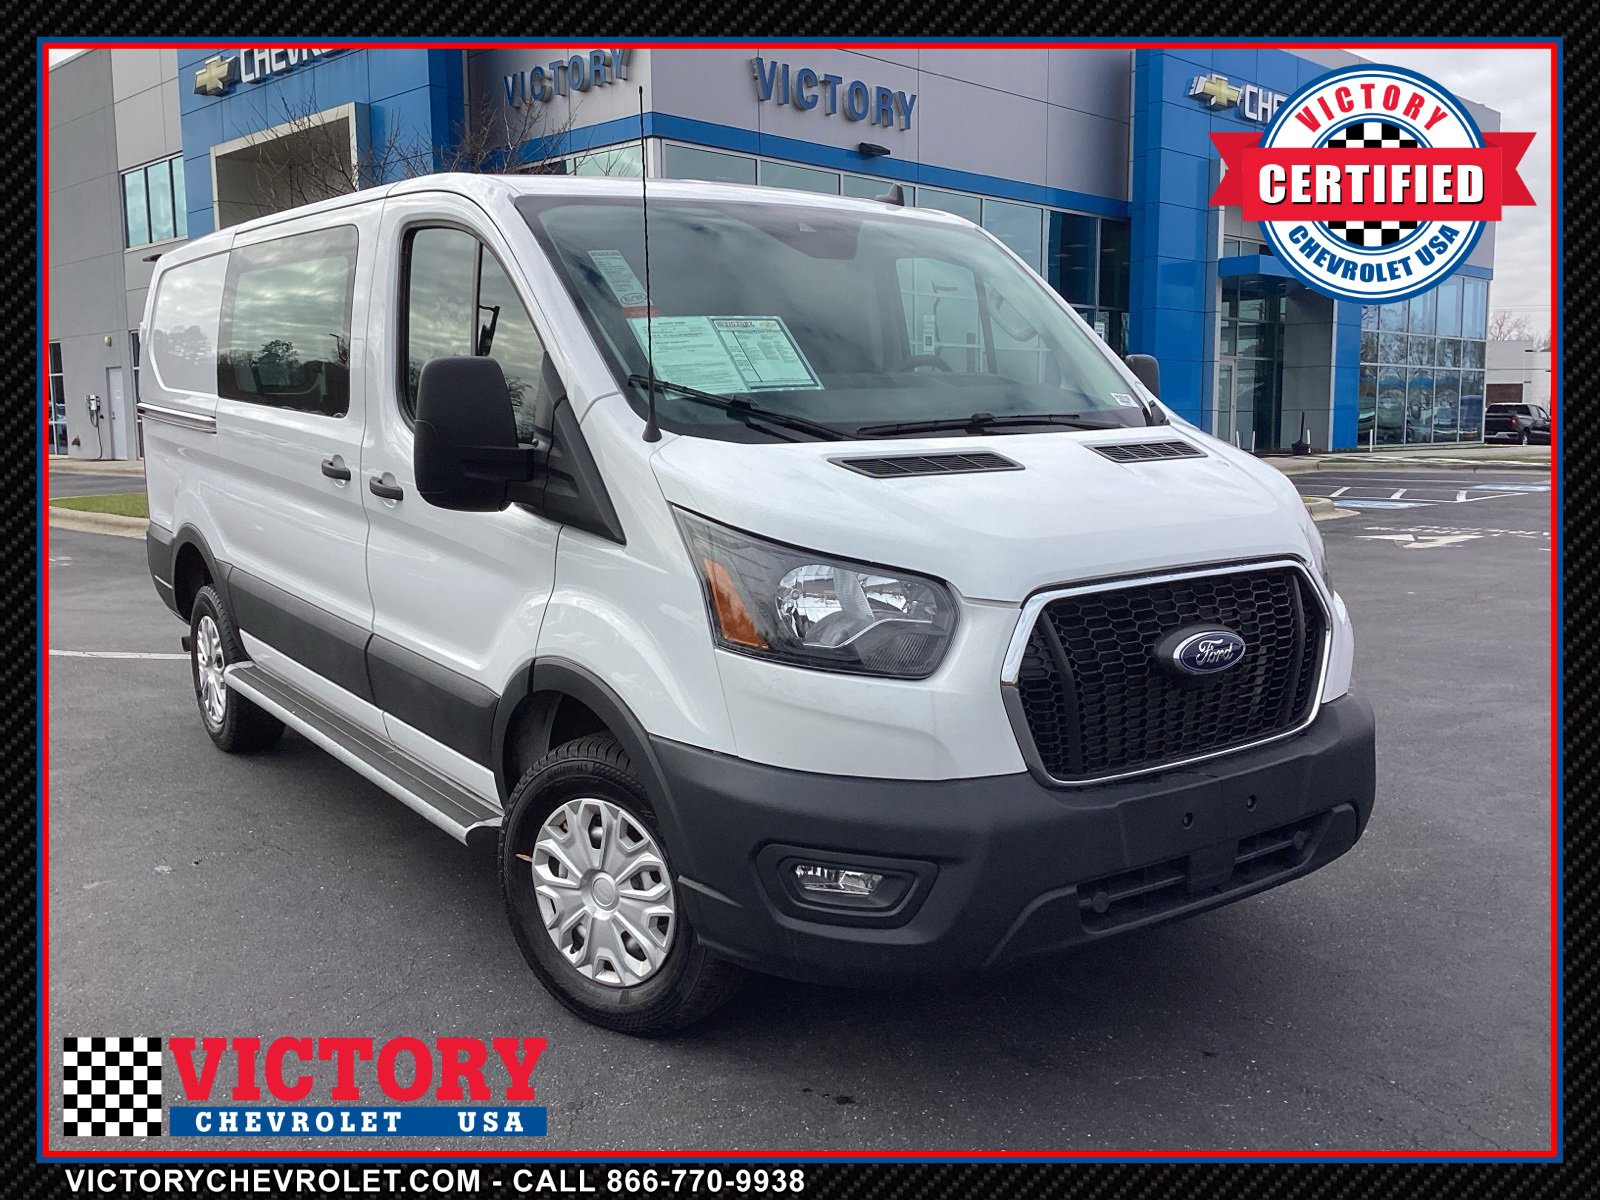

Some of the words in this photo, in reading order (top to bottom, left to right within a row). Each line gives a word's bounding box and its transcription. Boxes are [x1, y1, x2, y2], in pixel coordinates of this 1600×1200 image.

[504, 49, 630, 109] VICTORY
[752, 56, 917, 131] VICTORY
[1196, 638, 1234, 666] Ford
